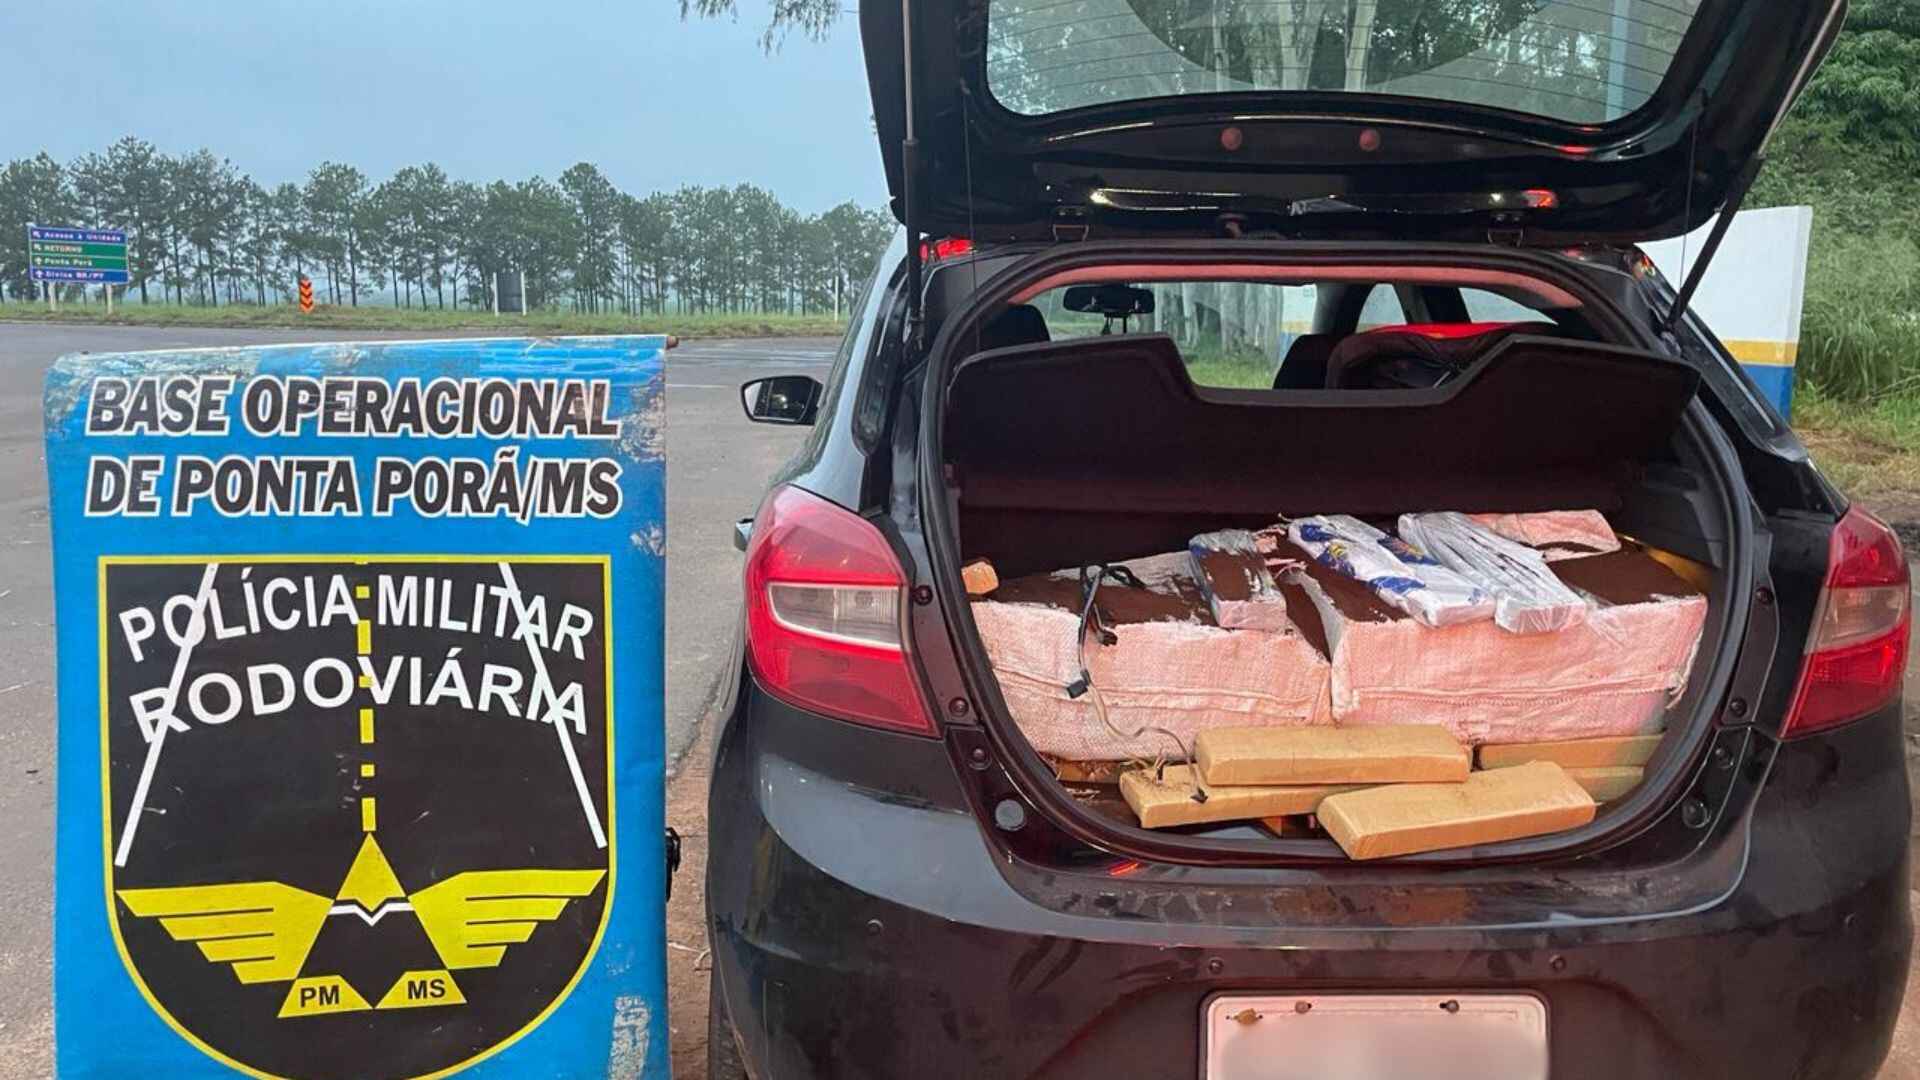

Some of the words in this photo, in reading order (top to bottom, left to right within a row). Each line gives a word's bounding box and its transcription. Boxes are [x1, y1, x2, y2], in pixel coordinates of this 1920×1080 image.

[44, 245, 83, 253] RETORNO
[44, 257, 70, 265] Ponta
[85, 375, 236, 436] BASE
[242, 375, 622, 439] OPERACIONAL
[84, 455, 165, 516] DE
[171, 455, 363, 517] PONTA
[372, 445, 624, 526] PORÃ/MS
[119, 567, 359, 662] POLÍCIA
[378, 574, 594, 660] MILITAR
[129, 648, 587, 743] RODOVIÁRIA
[300, 985, 340, 1007] PM
[407, 979, 446, 1000] MS
